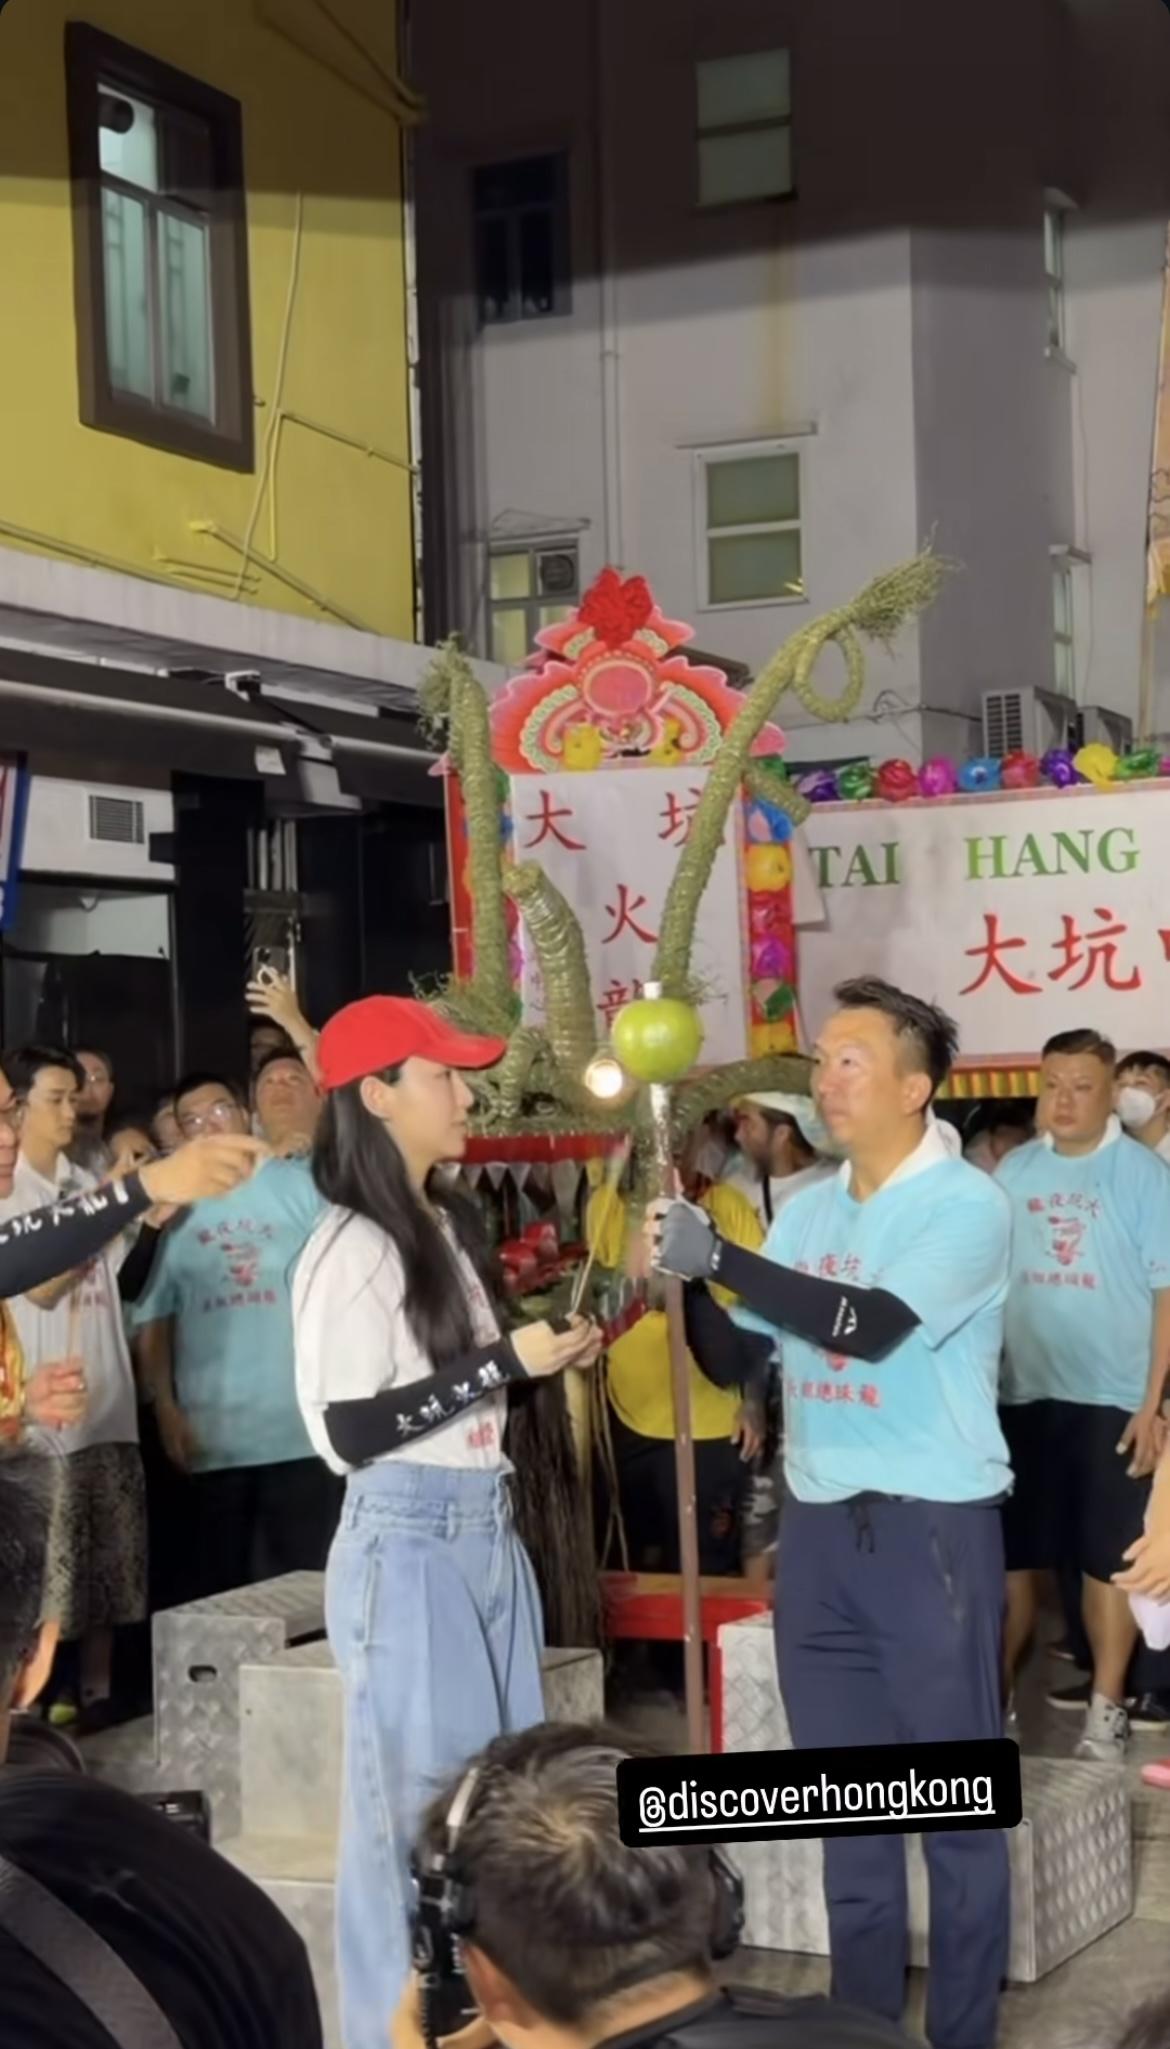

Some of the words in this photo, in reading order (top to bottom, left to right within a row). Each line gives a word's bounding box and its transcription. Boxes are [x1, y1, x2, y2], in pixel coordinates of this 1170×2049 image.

[809, 841, 901, 888] TAI
[963, 827, 1141, 881] HANG
[959, 908, 1170, 996] 大坑
